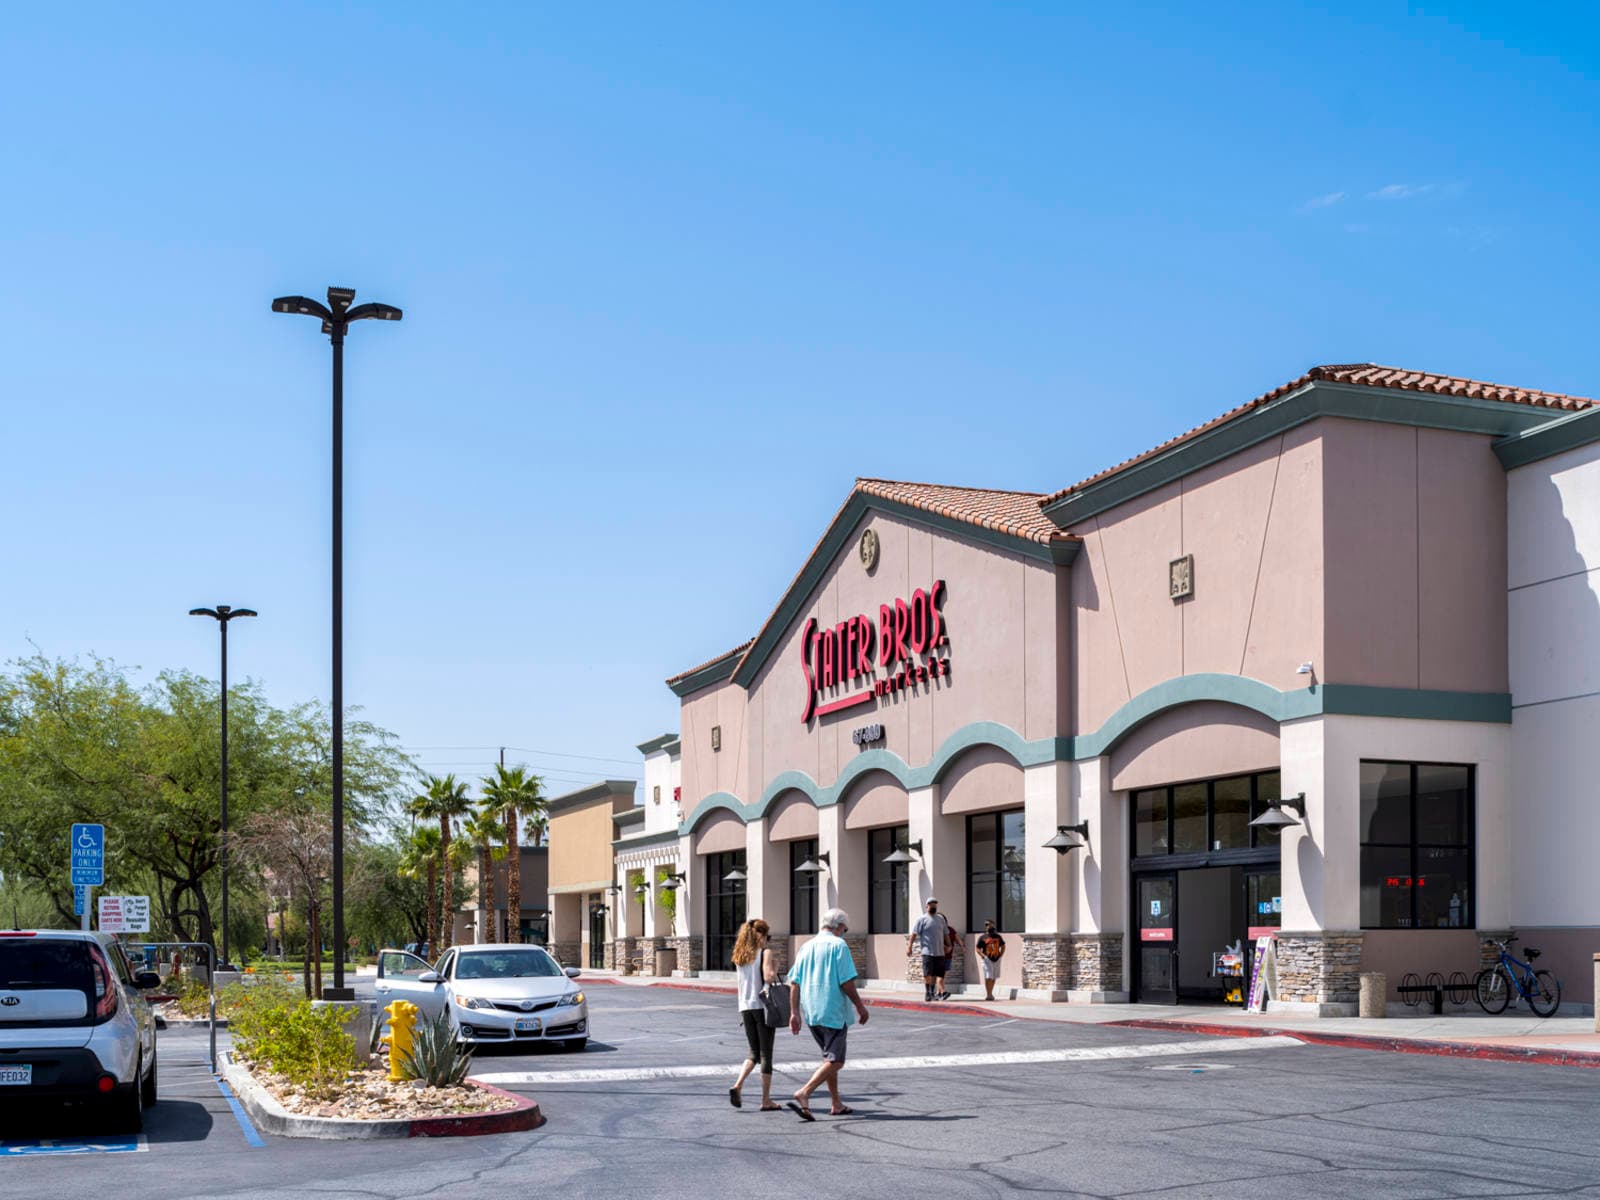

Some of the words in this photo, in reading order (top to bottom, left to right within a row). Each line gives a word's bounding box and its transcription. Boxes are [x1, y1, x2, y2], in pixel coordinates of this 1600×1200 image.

[801, 614, 873, 723] STATER
[880, 579, 948, 668] BROS.
[874, 657, 950, 697] markets
[73, 848, 102, 858] PARKING
[78, 859, 97, 867] ONLY
[1, 996, 19, 1006] KIA
